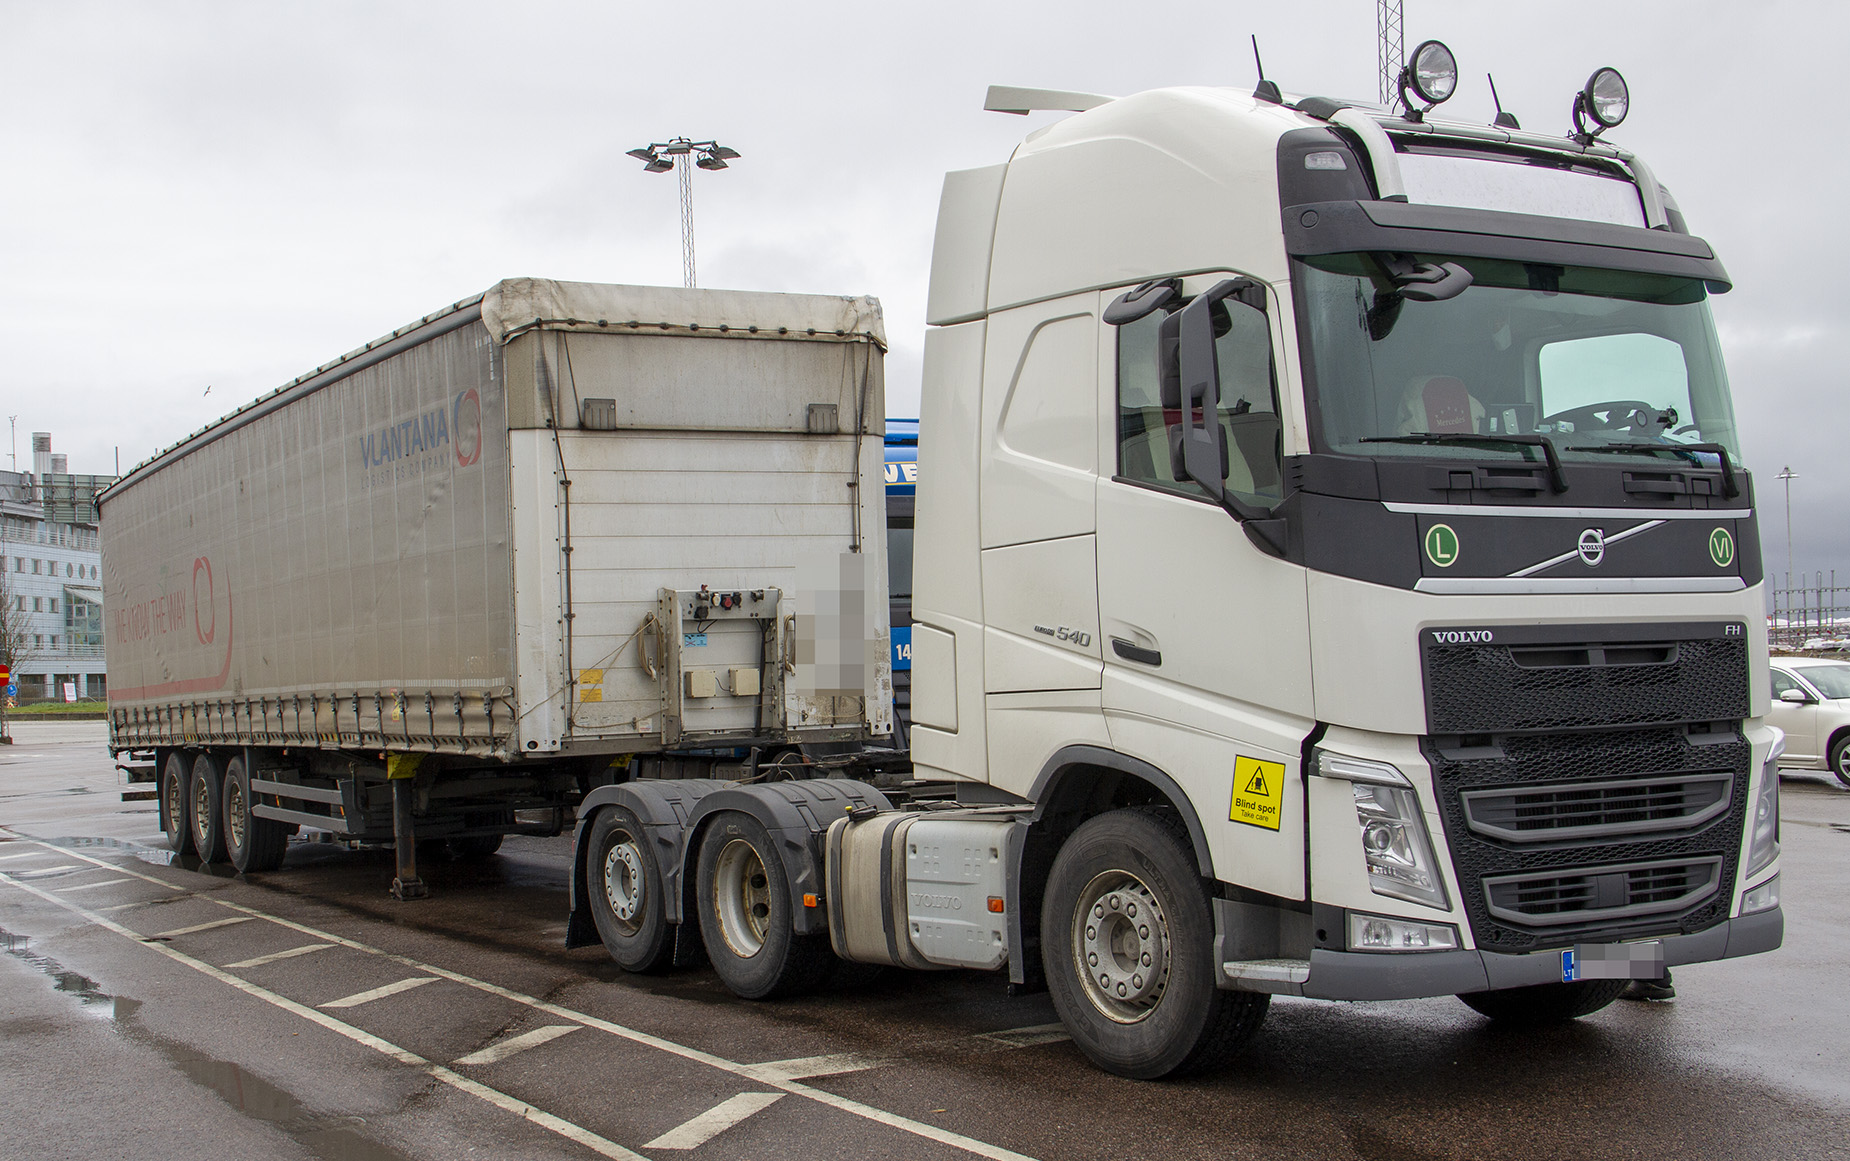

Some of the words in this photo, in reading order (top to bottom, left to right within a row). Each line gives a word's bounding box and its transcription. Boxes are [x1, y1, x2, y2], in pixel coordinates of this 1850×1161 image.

[360, 407, 450, 471] VLANTANA
[1435, 532, 1451, 559] L
[1579, 543, 1604, 551] VOLVO
[1712, 537, 1730, 559] VI
[114, 608, 128, 645] WE
[127, 600, 150, 642] KNOW
[150, 595, 167, 637] THE
[165, 588, 187, 633] WAY
[1055, 625, 1092, 648] 540
[1431, 629, 1494, 644] VOLVO
[1724, 624, 1741, 636] FH
[1235, 797, 1256, 810] Blind
[1257, 804, 1276, 815] spot
[1240, 809, 1255, 819] Take
[1255, 813, 1270, 822] care
[910, 892, 963, 911] VOLVO
[1563, 969, 1572, 978] LT
